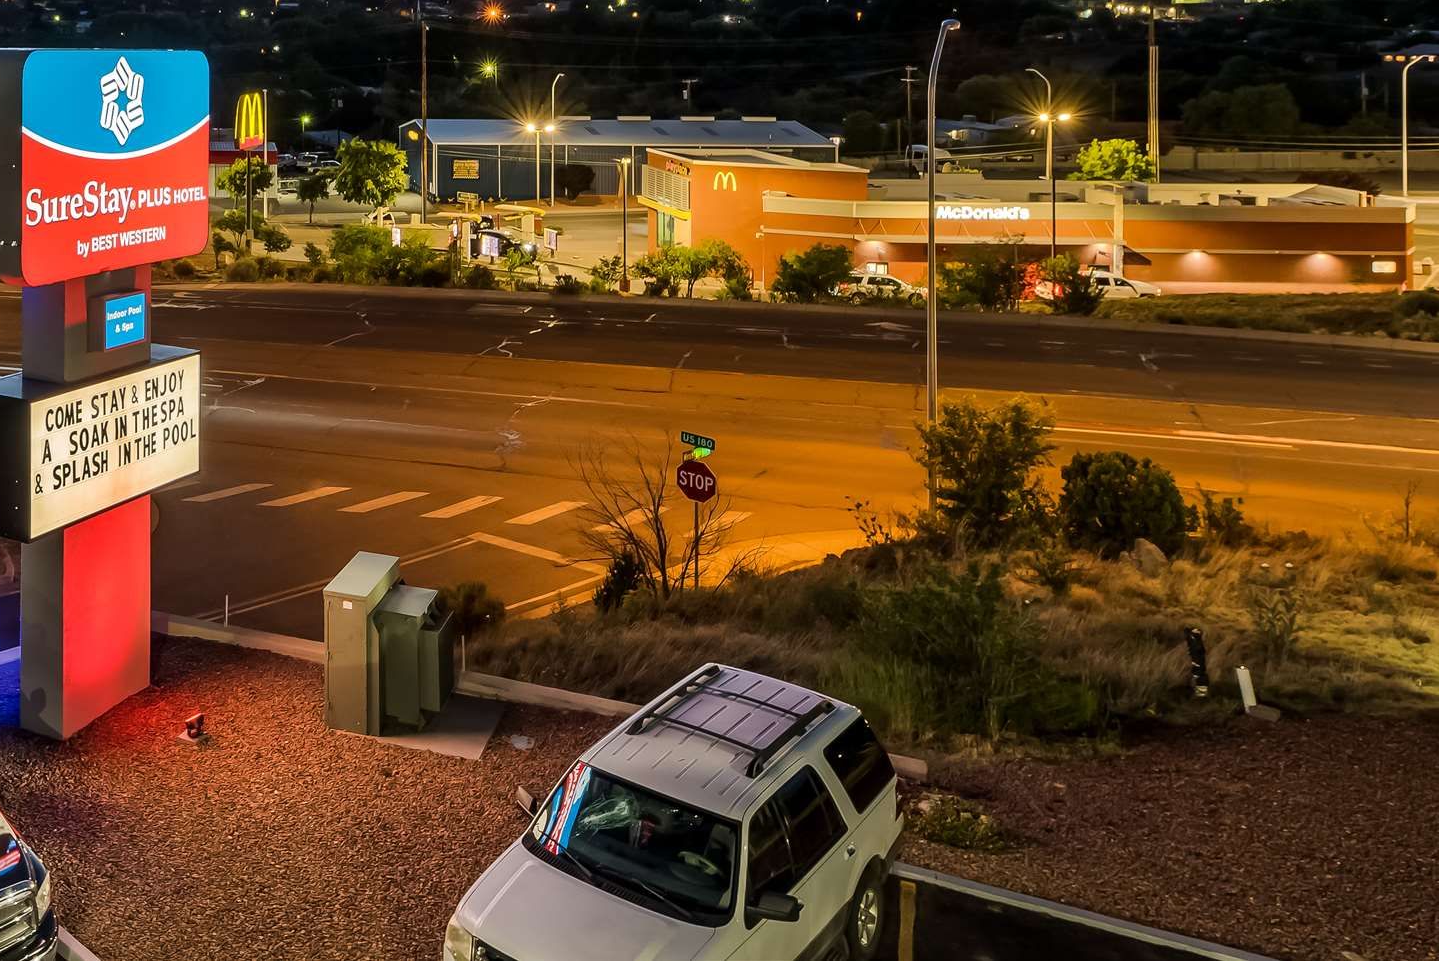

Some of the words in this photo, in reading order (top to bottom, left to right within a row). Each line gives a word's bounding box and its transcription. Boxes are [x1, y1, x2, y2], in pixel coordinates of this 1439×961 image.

[25, 180, 133, 226] SureStay
[138, 187, 171, 208] PLUS
[173, 186, 207, 204] HOTEL
[936, 206, 1030, 220] McDonald's
[76, 239, 90, 258] by
[91, 233, 119, 252] BEST
[119, 226, 166, 247] WESTERN
[107, 310, 127, 320] Indoor
[128, 305, 142, 315] Pool
[122, 322, 133, 332] Spa
[45, 400, 83, 432] COME
[91, 387, 126, 419] STAY
[131, 385, 139, 404] &
[144, 369, 184, 402] ENJOY
[42, 439, 52, 464] A
[69, 421, 109, 455] SOAK
[115, 415, 128, 440] IN
[683, 433, 695, 443] US
[697, 437, 713, 448] 180
[34, 473, 44, 494] &
[53, 450, 109, 490] SPLASH
[163, 418, 197, 449] POOL
[679, 470, 714, 492] STOP
